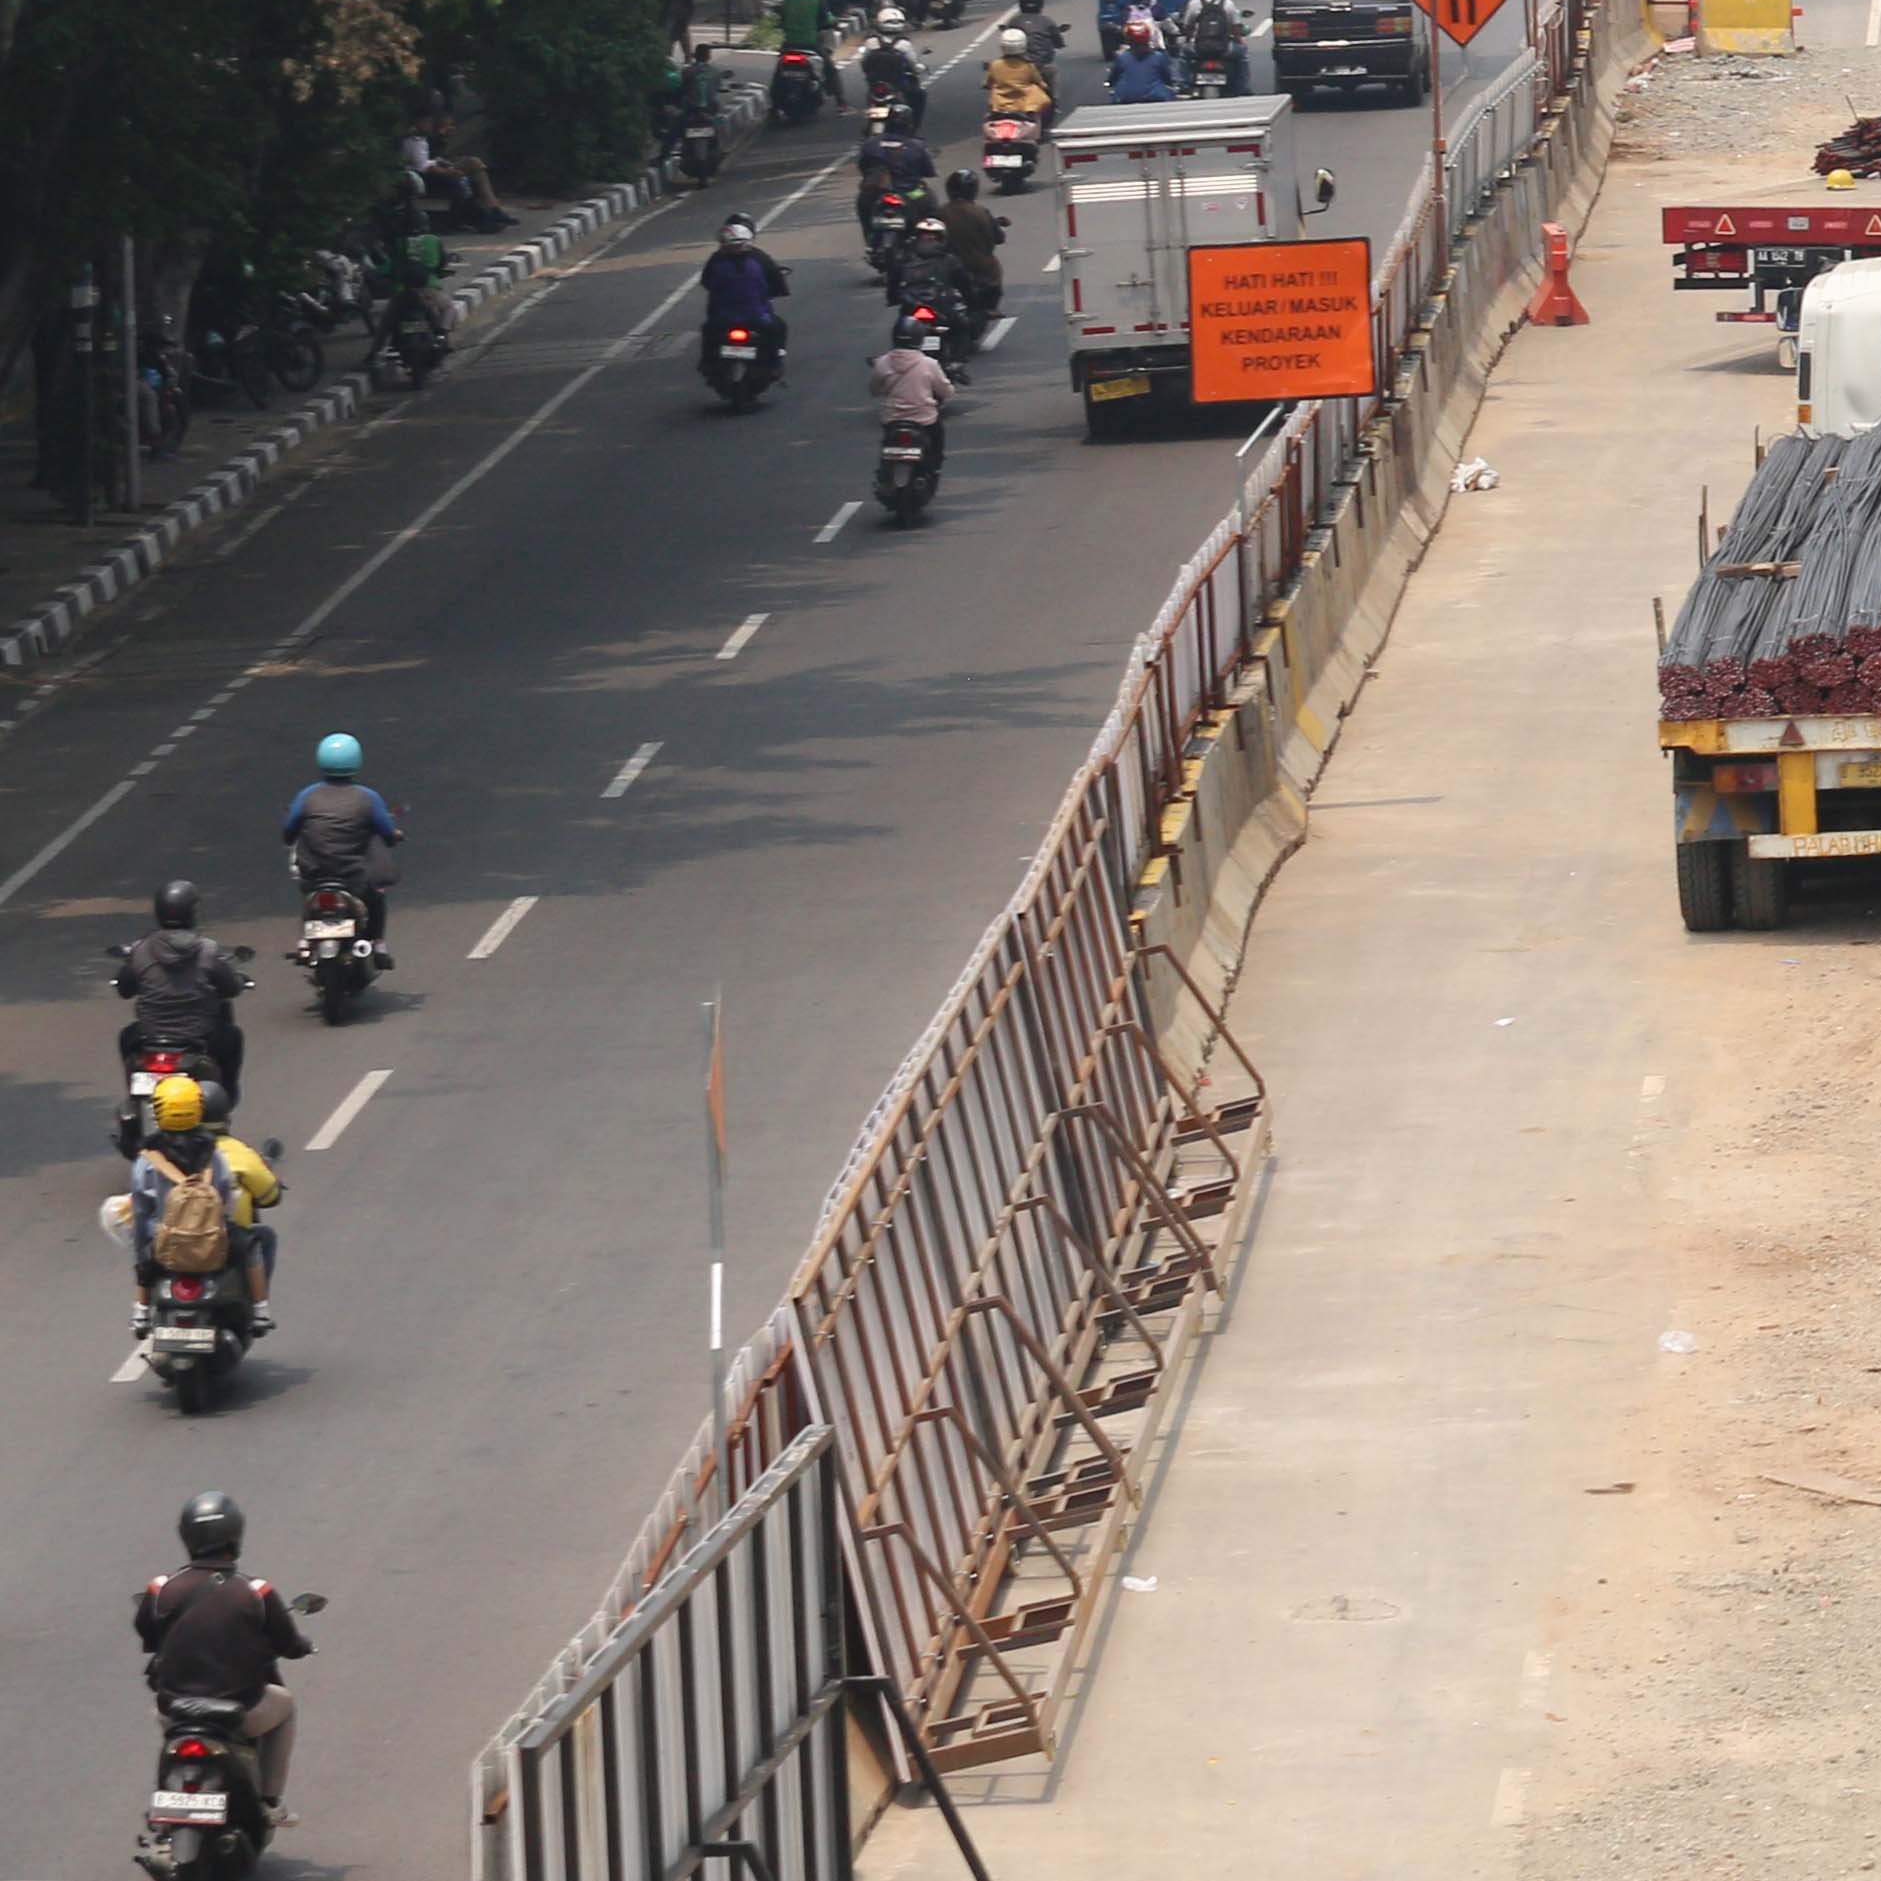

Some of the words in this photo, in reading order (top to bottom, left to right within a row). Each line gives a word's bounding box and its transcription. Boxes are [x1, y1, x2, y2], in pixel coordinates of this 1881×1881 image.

[1223, 273, 1267, 290] HATI
[1271, 271, 1314, 288] HATI
[1201, 299, 1278, 318] KELUAR
[1289, 296, 1358, 314] MASUK
[1220, 325, 1342, 346] KENDARAAN
[1241, 353, 1321, 372] PROYEK
